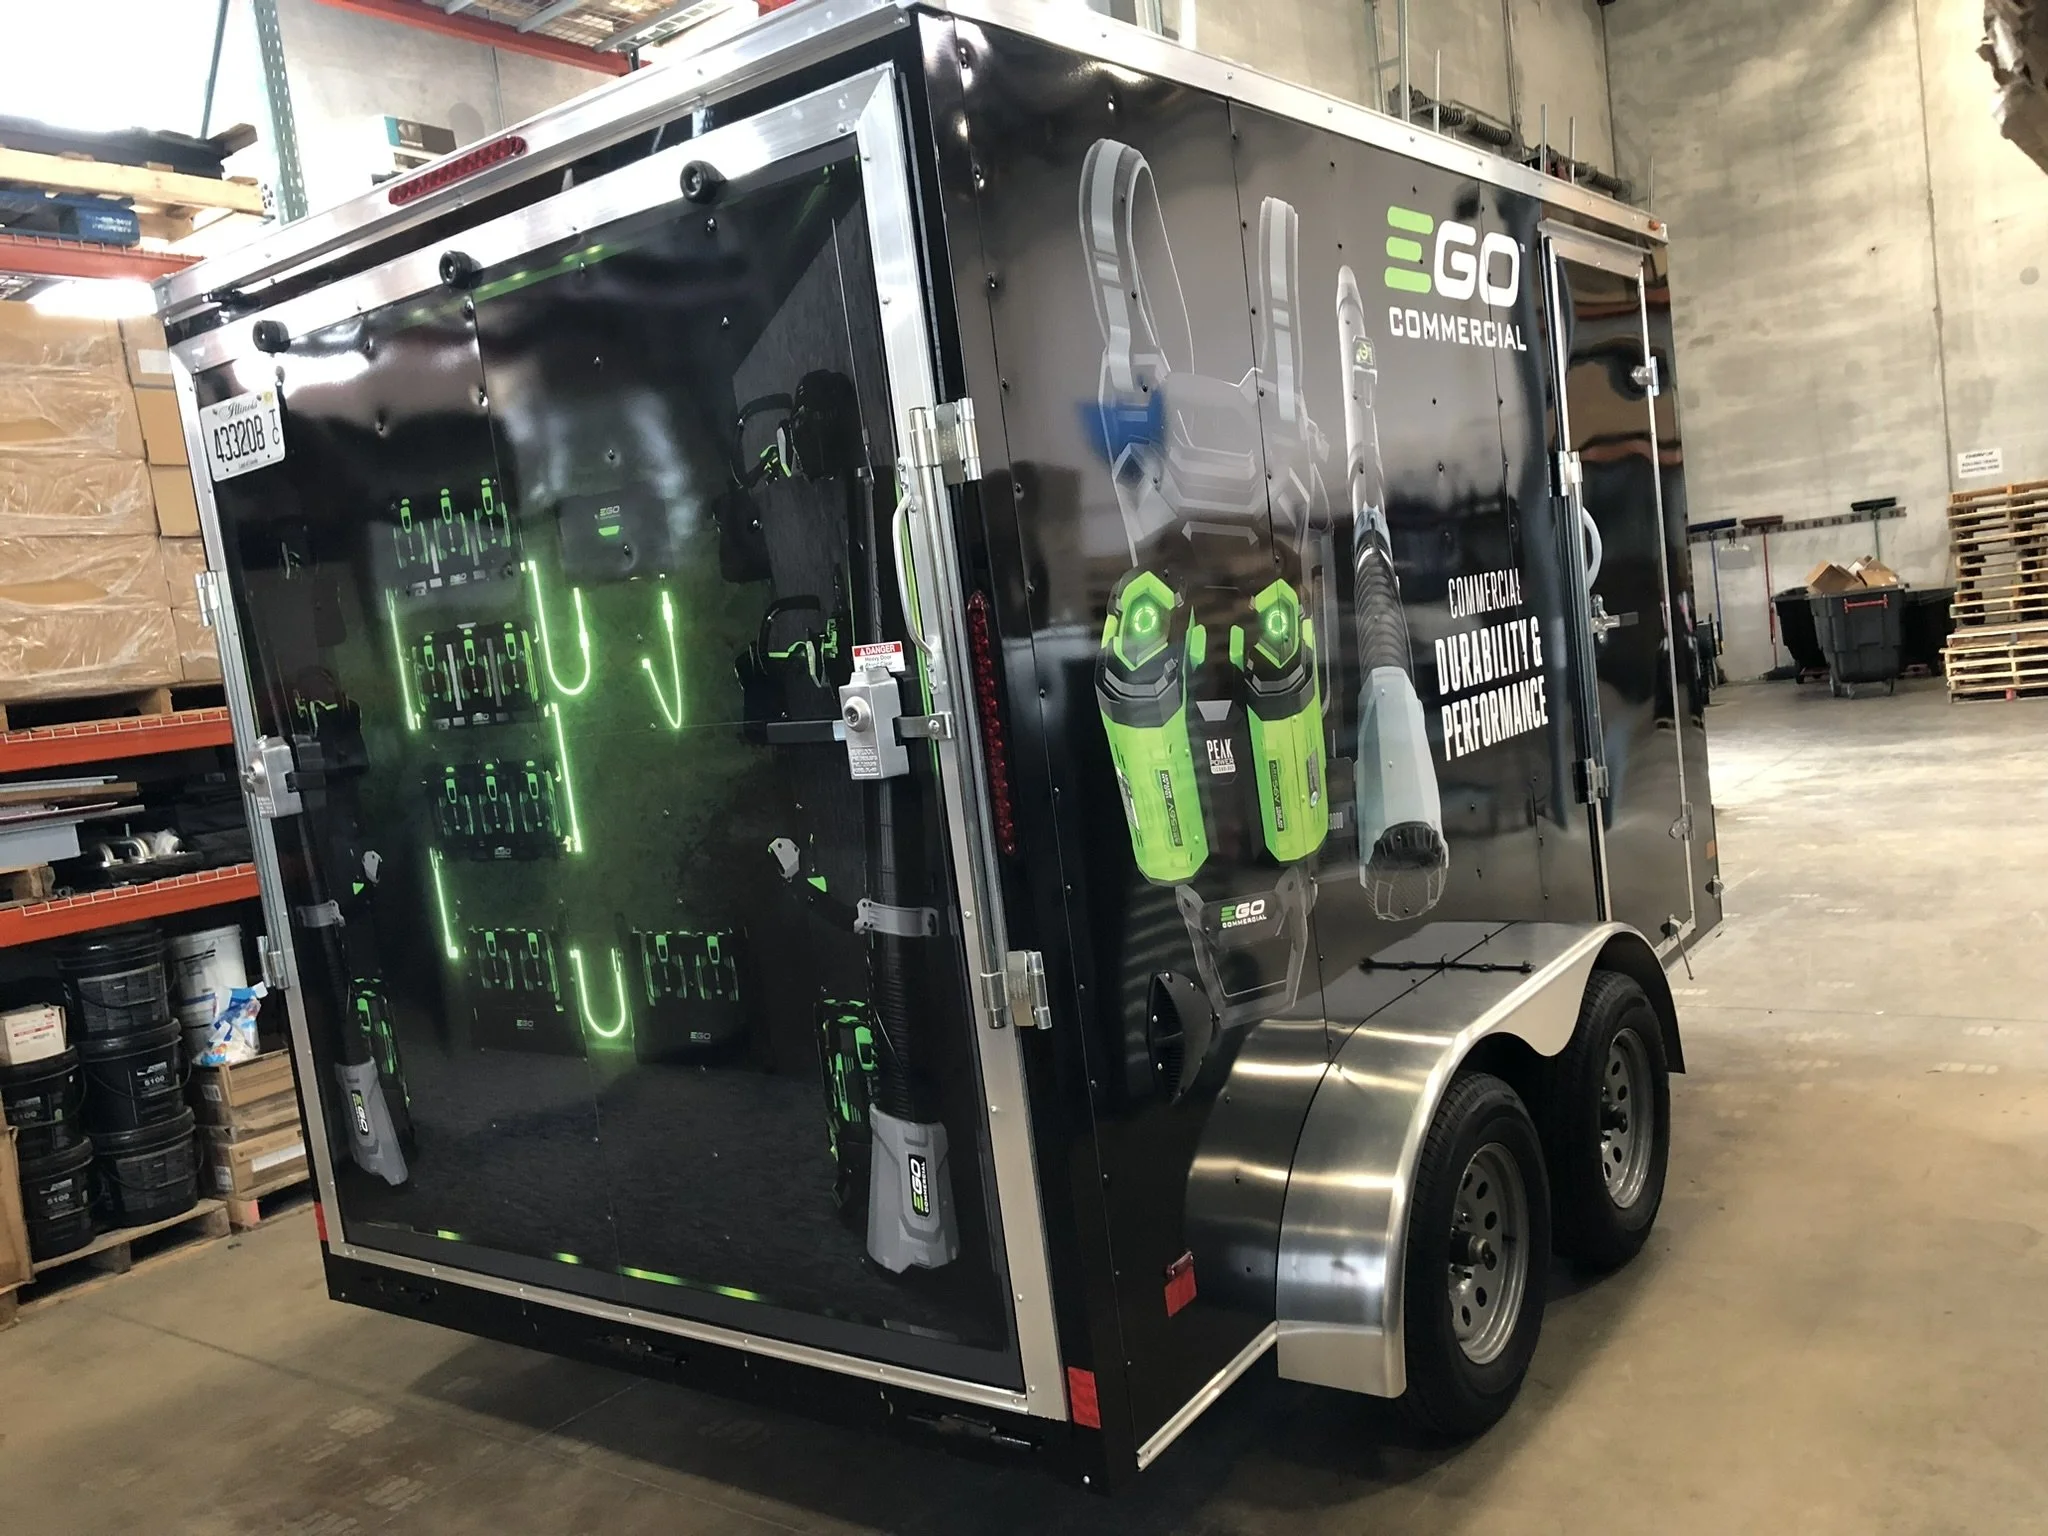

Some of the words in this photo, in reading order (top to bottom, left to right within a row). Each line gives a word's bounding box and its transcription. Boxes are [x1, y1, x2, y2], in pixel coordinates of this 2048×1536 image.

[1384, 205, 1520, 308] EGO
[1389, 306, 1527, 351] COMMERCIAL
[226, 401, 258, 419] Illinois
[214, 414, 265, 463] 43320B
[600, 505, 620, 516] EGO
[1448, 567, 1523, 619] COMMERCIAL
[866, 644, 896, 655] DANGER
[1434, 618, 1529, 696] DURABILITY
[1530, 615, 1543, 668] &
[1441, 674, 1549, 762] PERFORMANCE
[1206, 738, 1233, 760] PEAK
[1221, 899, 1265, 921] EGO
[1222, 914, 1267, 928] COMMERCIAL
[690, 1031, 711, 1040] EGO
[354, 1093, 369, 1132] EGO
[911, 1158, 924, 1212] EGO
[921, 1161, 929, 1213] COMMERCIAL
